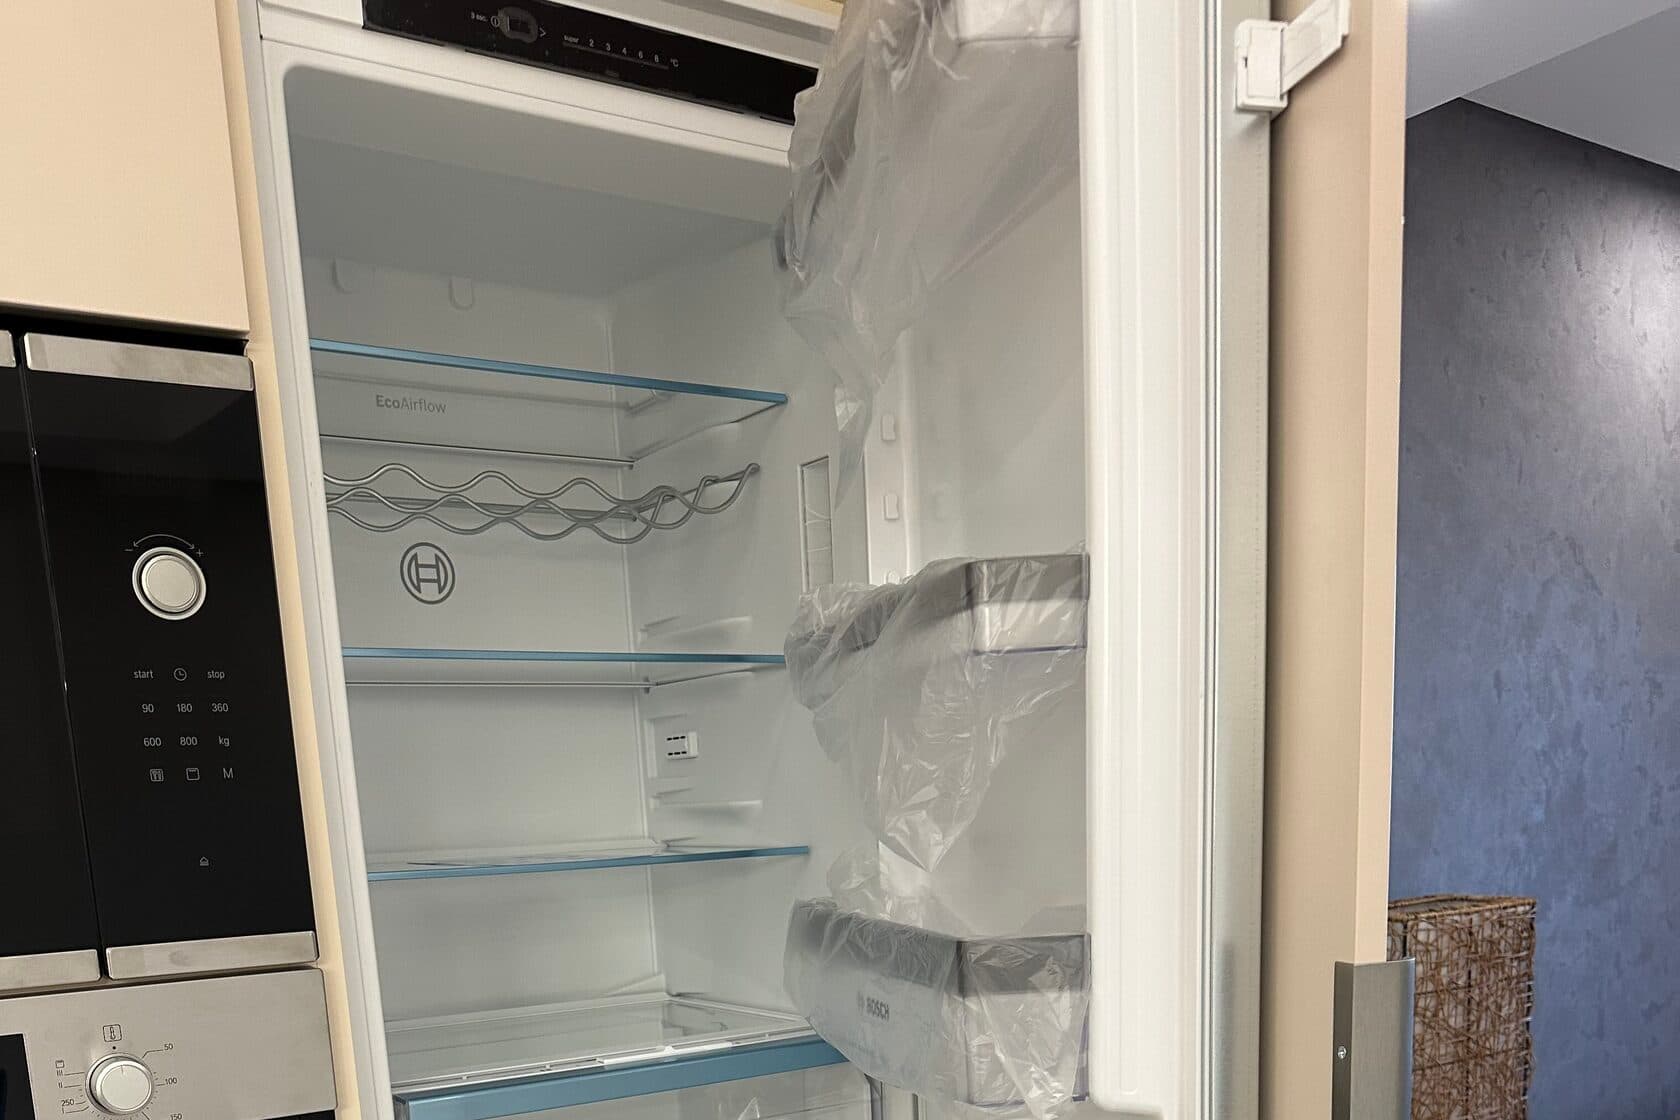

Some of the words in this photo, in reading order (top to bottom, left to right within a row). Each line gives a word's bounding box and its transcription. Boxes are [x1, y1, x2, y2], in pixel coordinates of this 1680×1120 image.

[589, 39, 594, 48] 2
[606, 43, 611, 52] 3
[622, 47, 627, 56] 4
[670, 58, 679, 67] °C
[376, 394, 447, 413] EcoAirflow
[133, 669, 154, 679] start
[207, 670, 226, 680] stop
[142, 703, 155, 713] 90
[176, 703, 193, 713] 180
[211, 702, 229, 713] 360
[143, 737, 162, 747] 600
[180, 736, 198, 746] 800
[218, 736, 230, 747] kg
[222, 767, 234, 779] M
[164, 1043, 174, 1051] 50
[165, 1077, 178, 1086] 100
[61, 1098, 75, 1107] 250
[170, 1112, 183, 1120] 150
